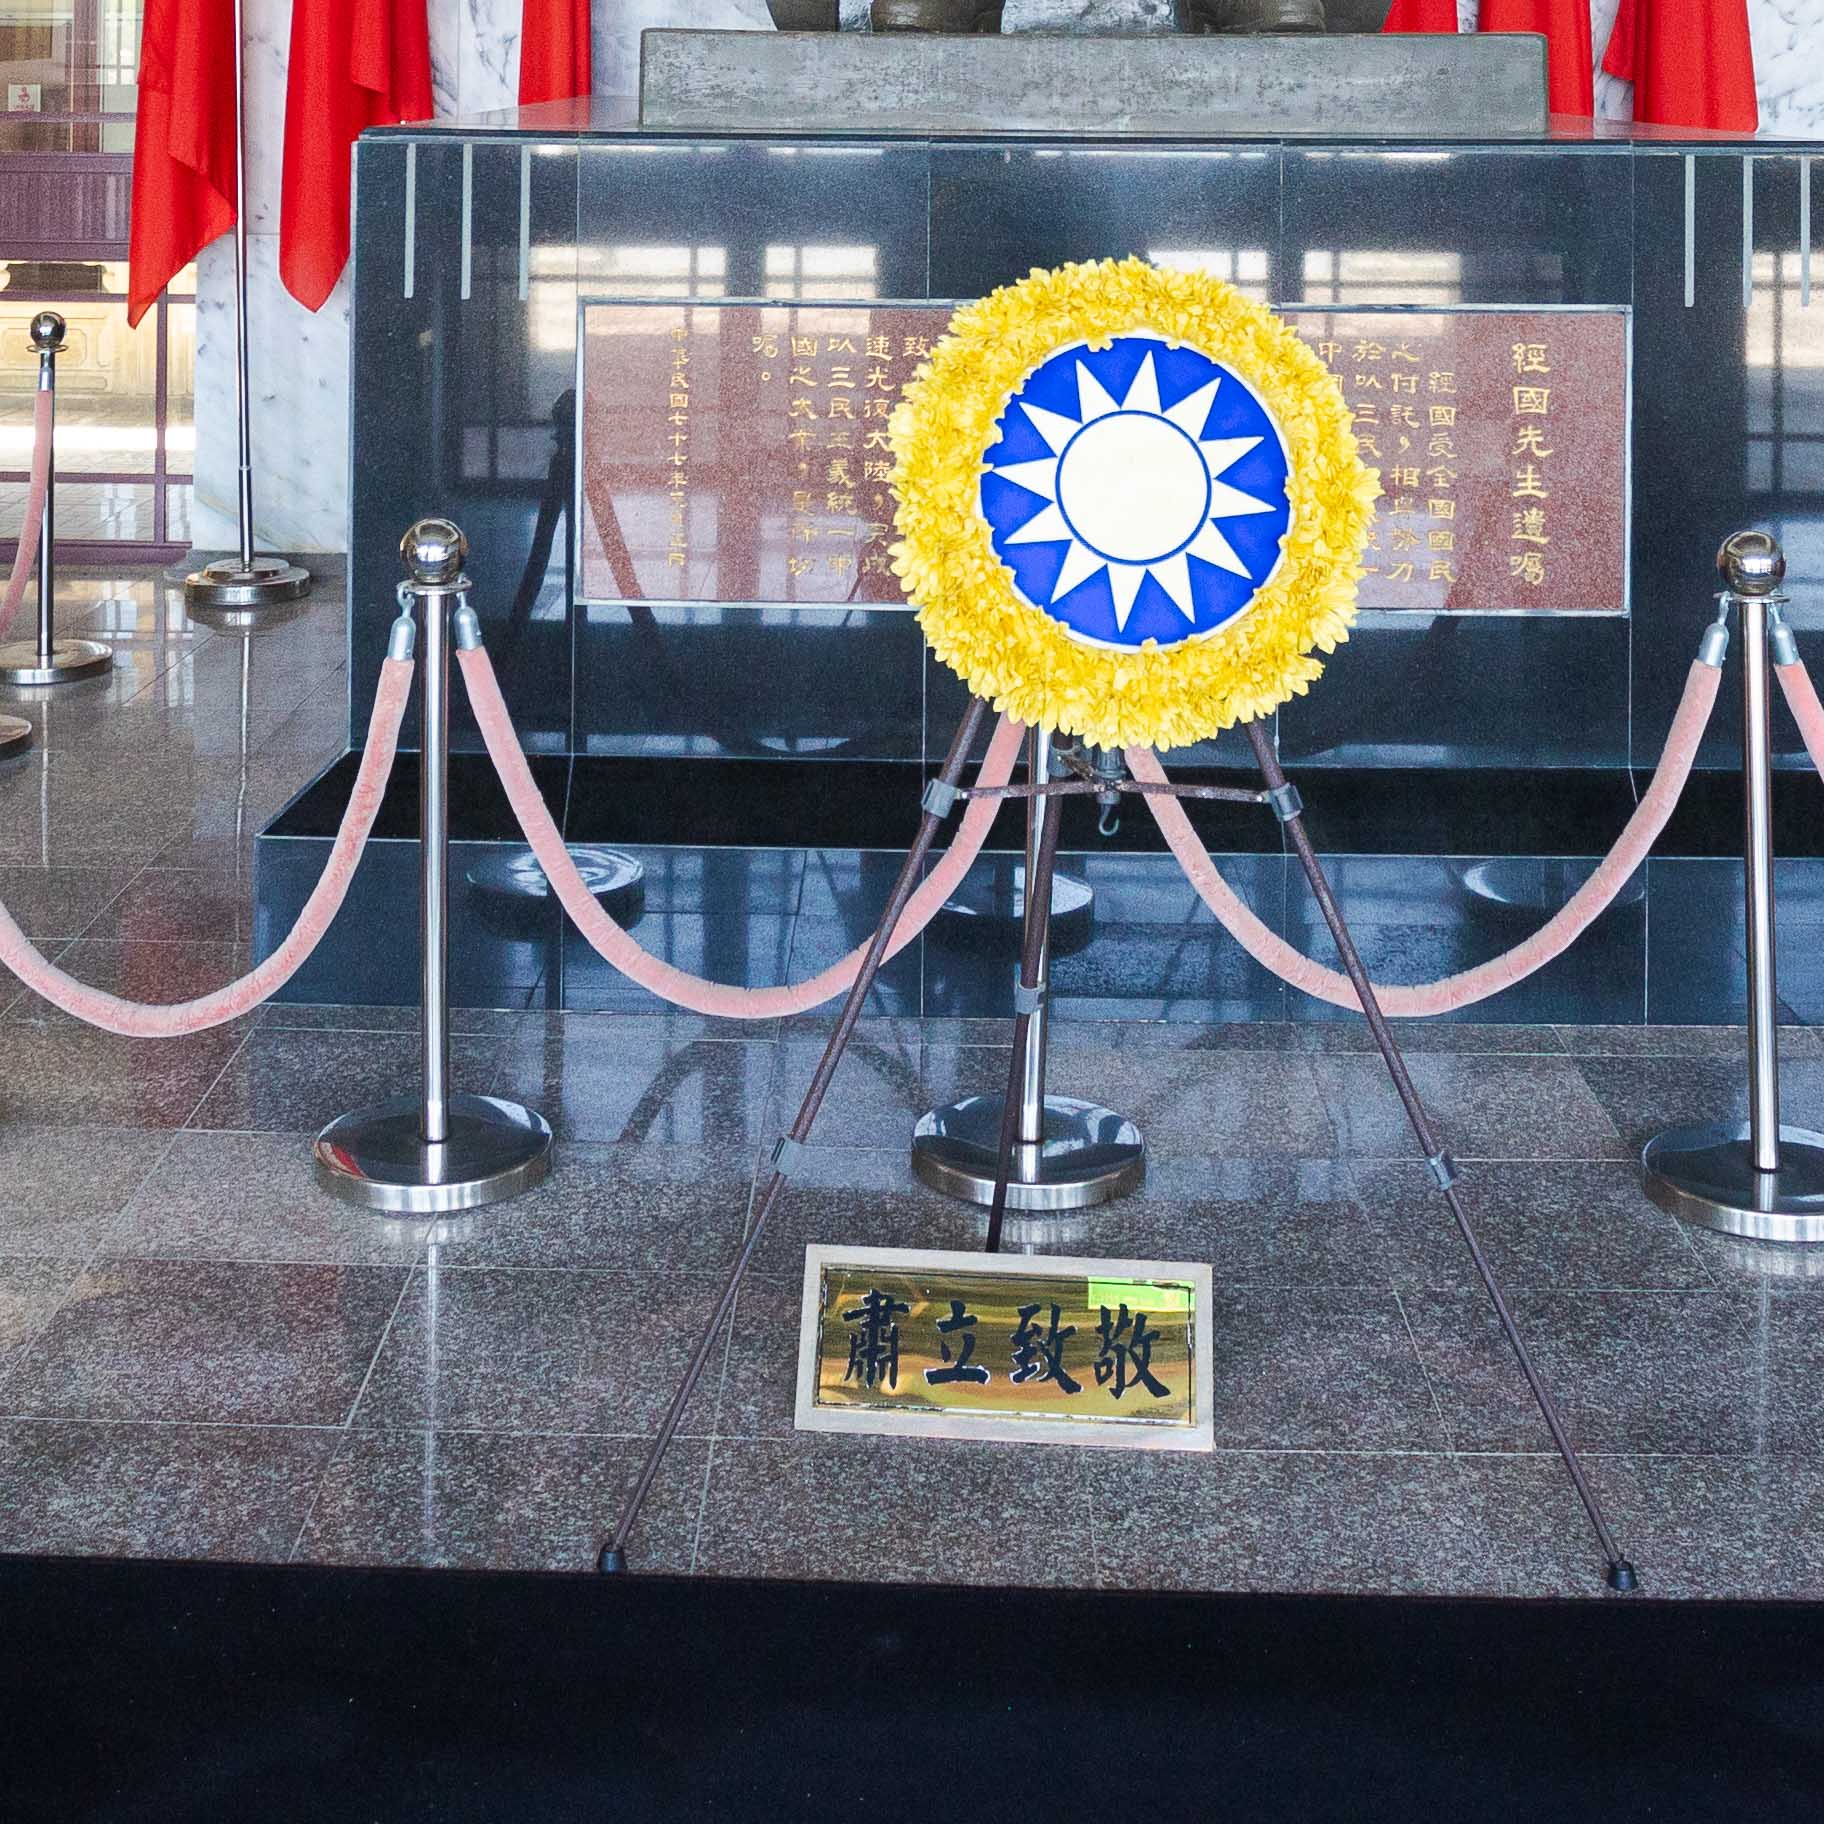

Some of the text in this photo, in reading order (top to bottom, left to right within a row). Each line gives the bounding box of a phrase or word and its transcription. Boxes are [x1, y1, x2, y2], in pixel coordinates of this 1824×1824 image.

[1426, 371, 1457, 583] 經國受全國國民
[1510, 342, 1554, 585] 經國先生遺囑
[842, 1288, 1171, 1401] 肅立致敬
